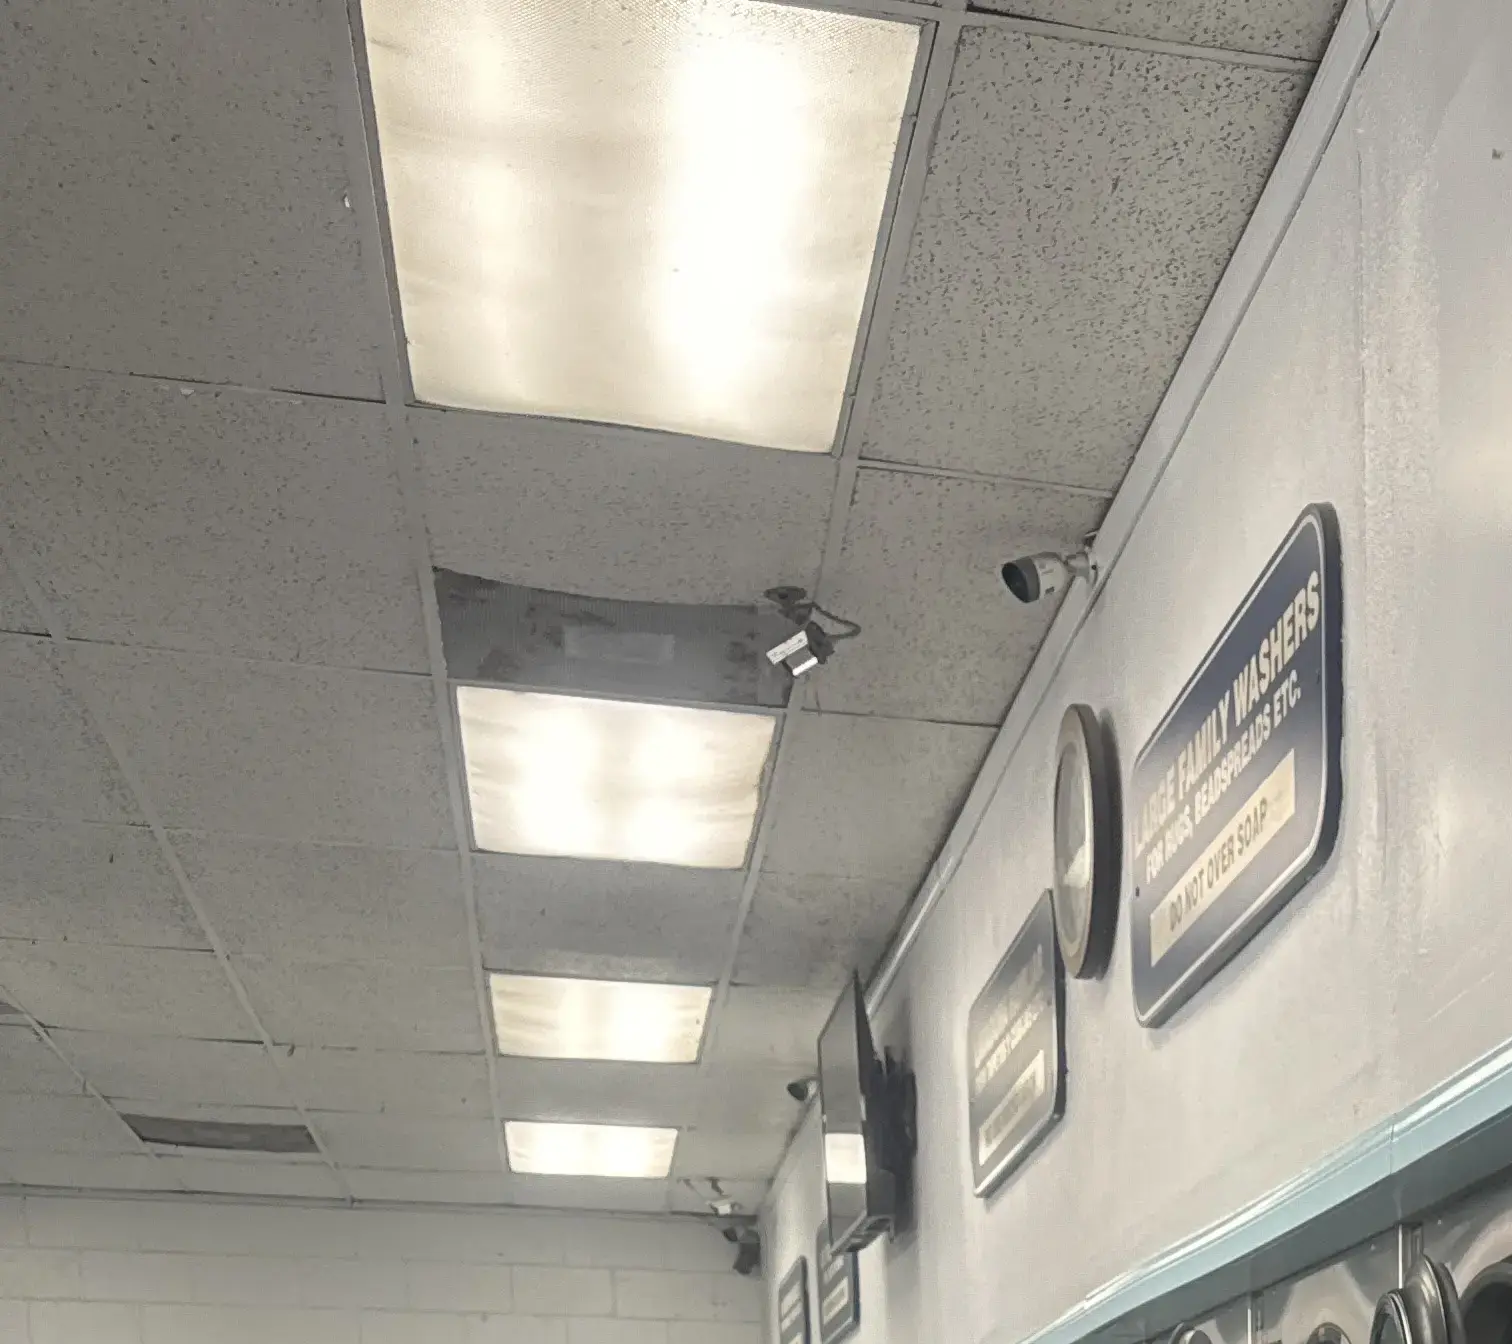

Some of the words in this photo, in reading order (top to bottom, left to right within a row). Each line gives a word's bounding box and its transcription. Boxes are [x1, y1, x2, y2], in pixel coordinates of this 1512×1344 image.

[1133, 762, 1176, 861] LARGE
[1178, 690, 1230, 800] FAMILY
[1233, 570, 1320, 727] WASHERS
[1146, 837, 1164, 885] FOR
[1273, 669, 1301, 728] ETC.
[1169, 893, 1182, 931] DO
[1184, 869, 1205, 915] NOT
[1207, 835, 1234, 889] OVER
[1237, 797, 1268, 857] SOAP
